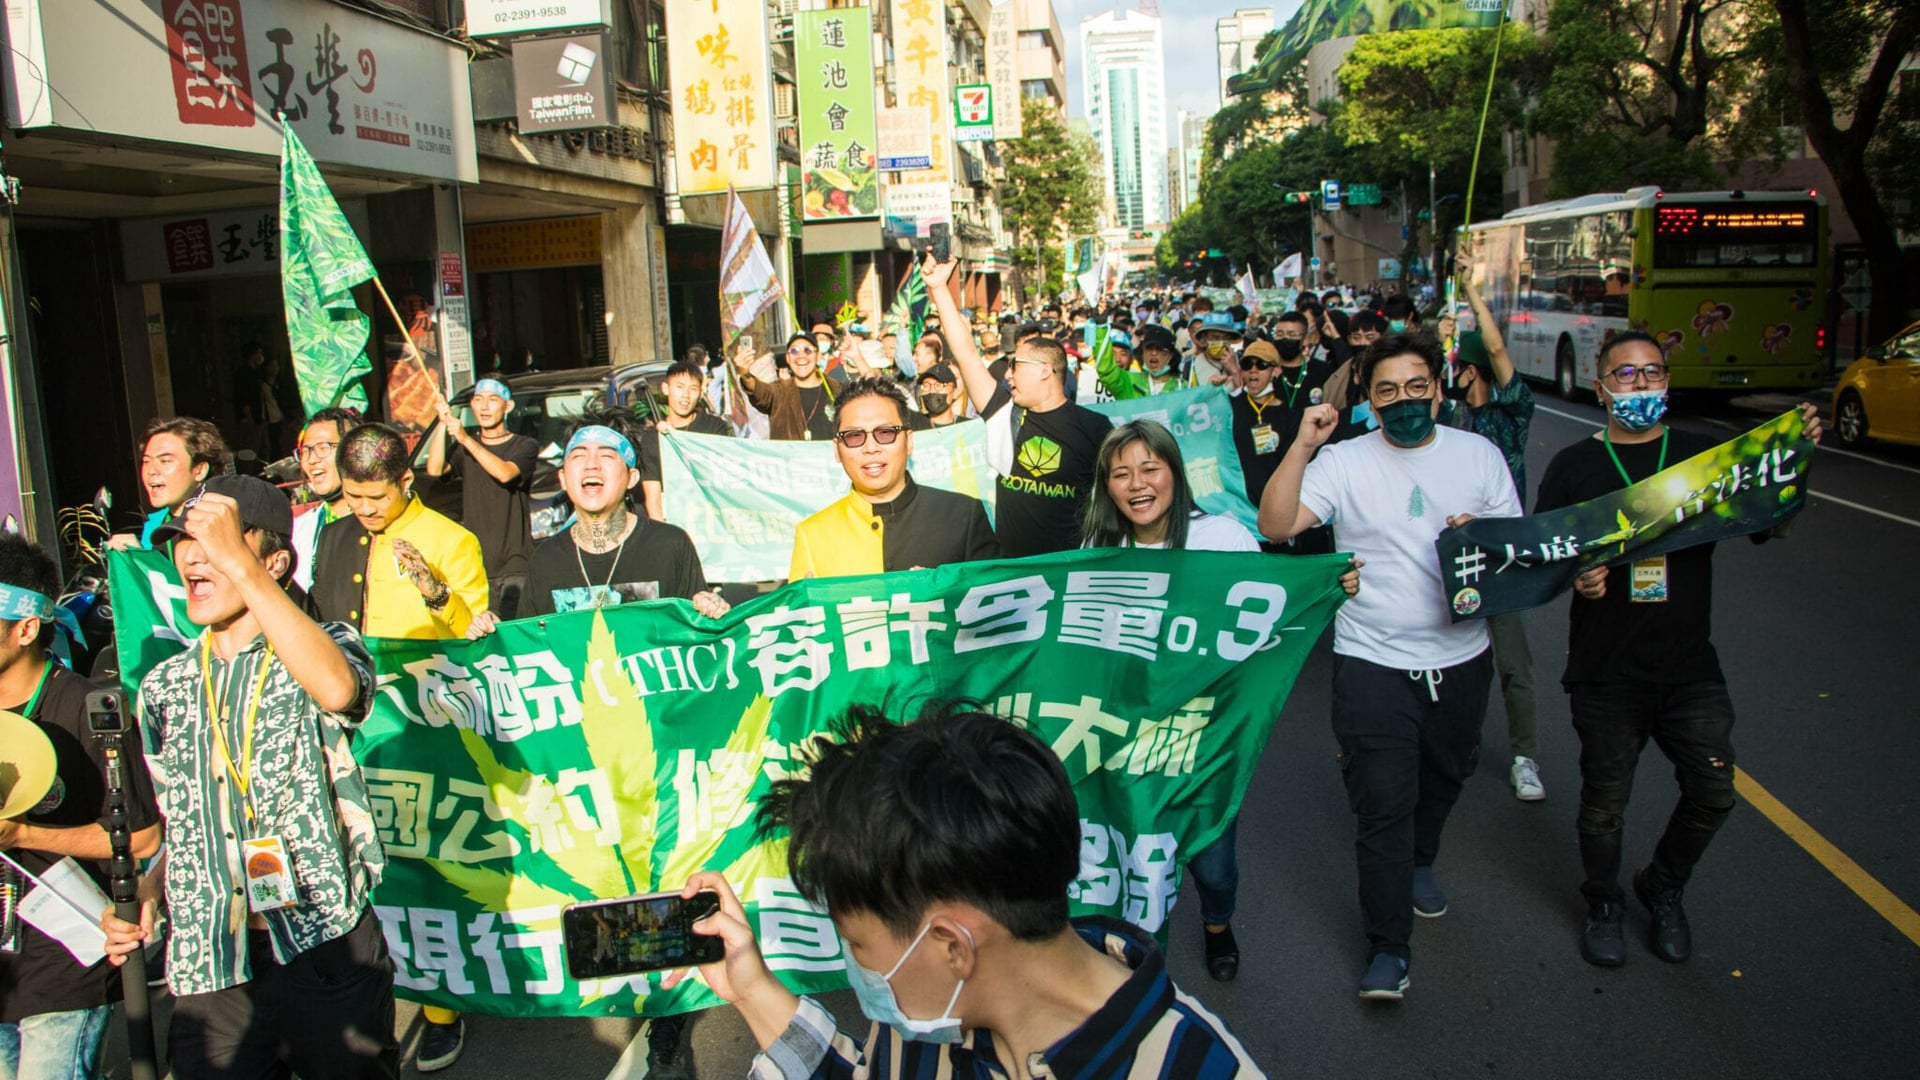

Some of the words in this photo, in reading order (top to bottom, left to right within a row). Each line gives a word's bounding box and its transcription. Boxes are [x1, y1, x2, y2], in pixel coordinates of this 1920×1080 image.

[495, 6, 567, 22] 02-2391-9538
[684, 0, 739, 172] 味鵝肉
[822, 19, 849, 131] 蓮池會
[532, 92, 595, 109] 國家電影中心
[815, 140, 867, 169] 蔬食
